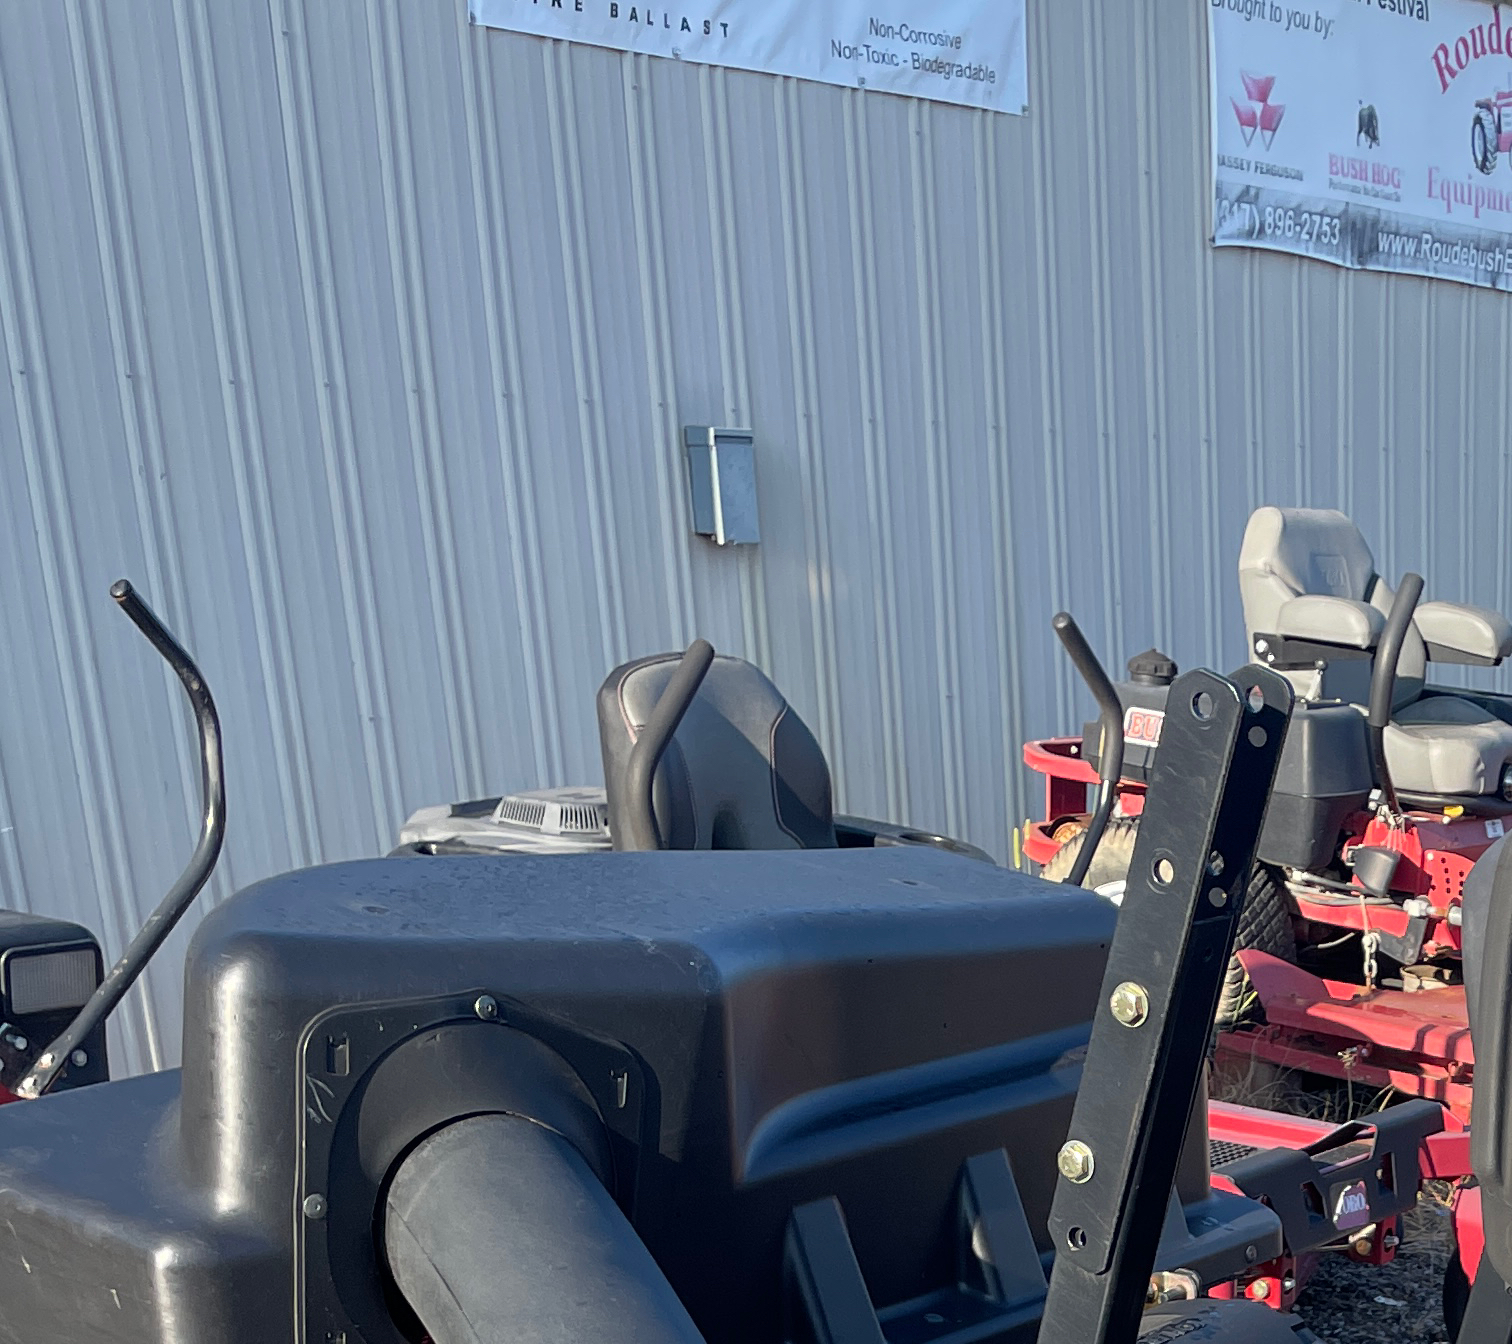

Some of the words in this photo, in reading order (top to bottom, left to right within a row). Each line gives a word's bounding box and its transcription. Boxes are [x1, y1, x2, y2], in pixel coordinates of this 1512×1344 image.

[610, 2, 729, 38] BALLAST
[1269, 4, 1283, 23] to
[1285, 11, 1310, 31] you
[1366, 0, 1429, 21] estival
[869, 17, 962, 50] Non-Corrosive
[831, 39, 900, 67] Non-Toxic
[911, 52, 996, 84] Biodegradable
[1217, 154, 1251, 173] ASSEY
[1328, 152, 1369, 183] BUSH
[1372, 161, 1402, 189] HOG
[1264, 206, 1341, 246] 896-2753
[1128, 713, 1163, 741] BU
